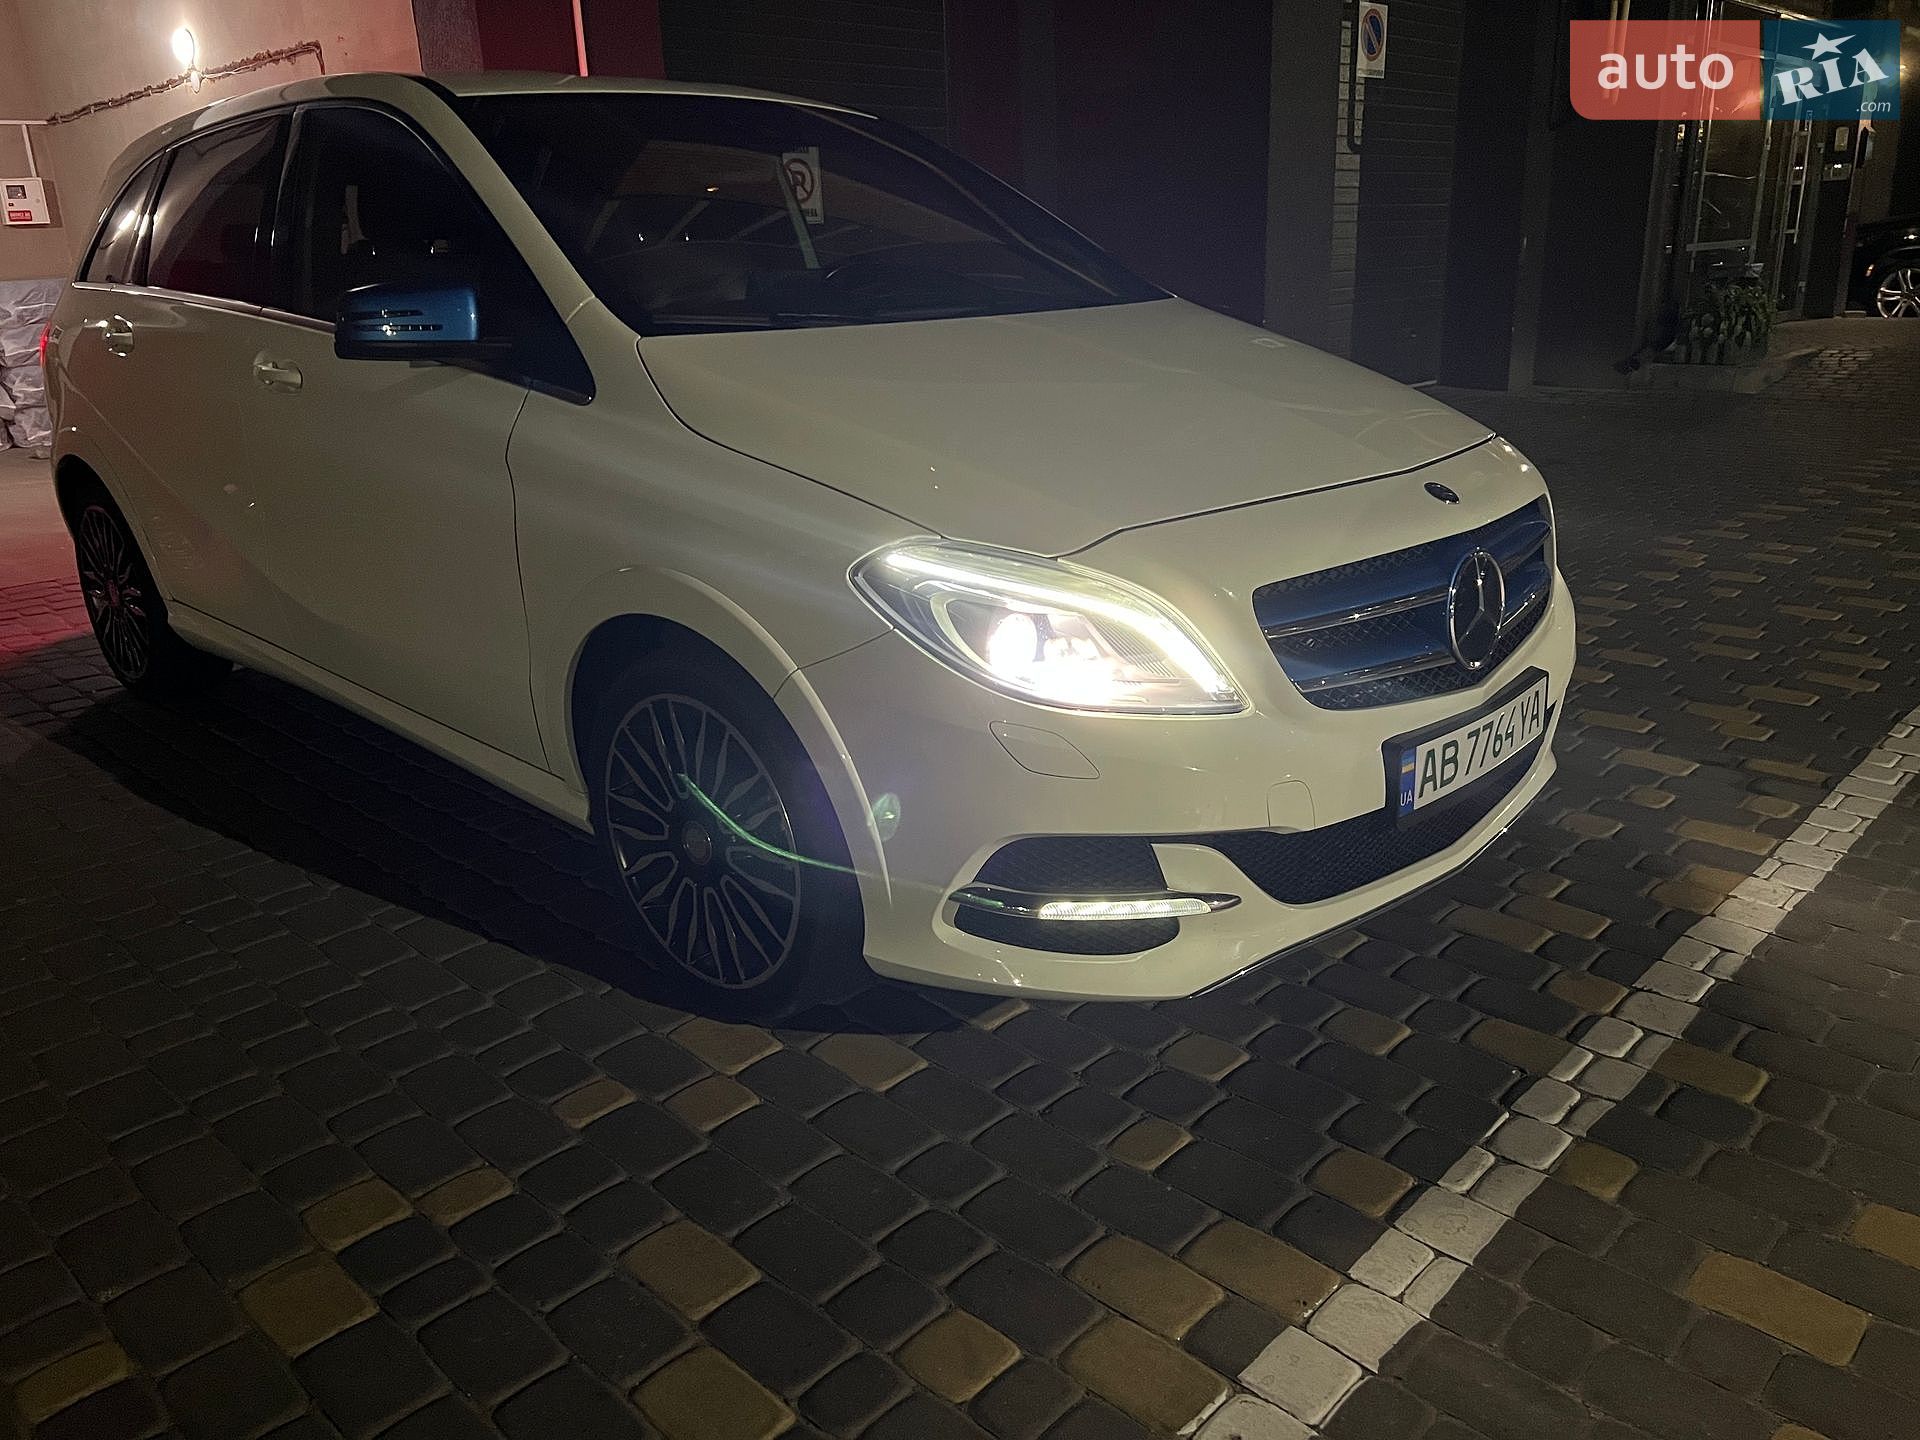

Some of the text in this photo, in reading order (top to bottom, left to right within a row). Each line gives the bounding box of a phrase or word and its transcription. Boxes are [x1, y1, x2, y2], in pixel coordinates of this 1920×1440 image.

[1418, 690, 1541, 799] AB 7764 YA
[1400, 790, 1413, 806] UA
